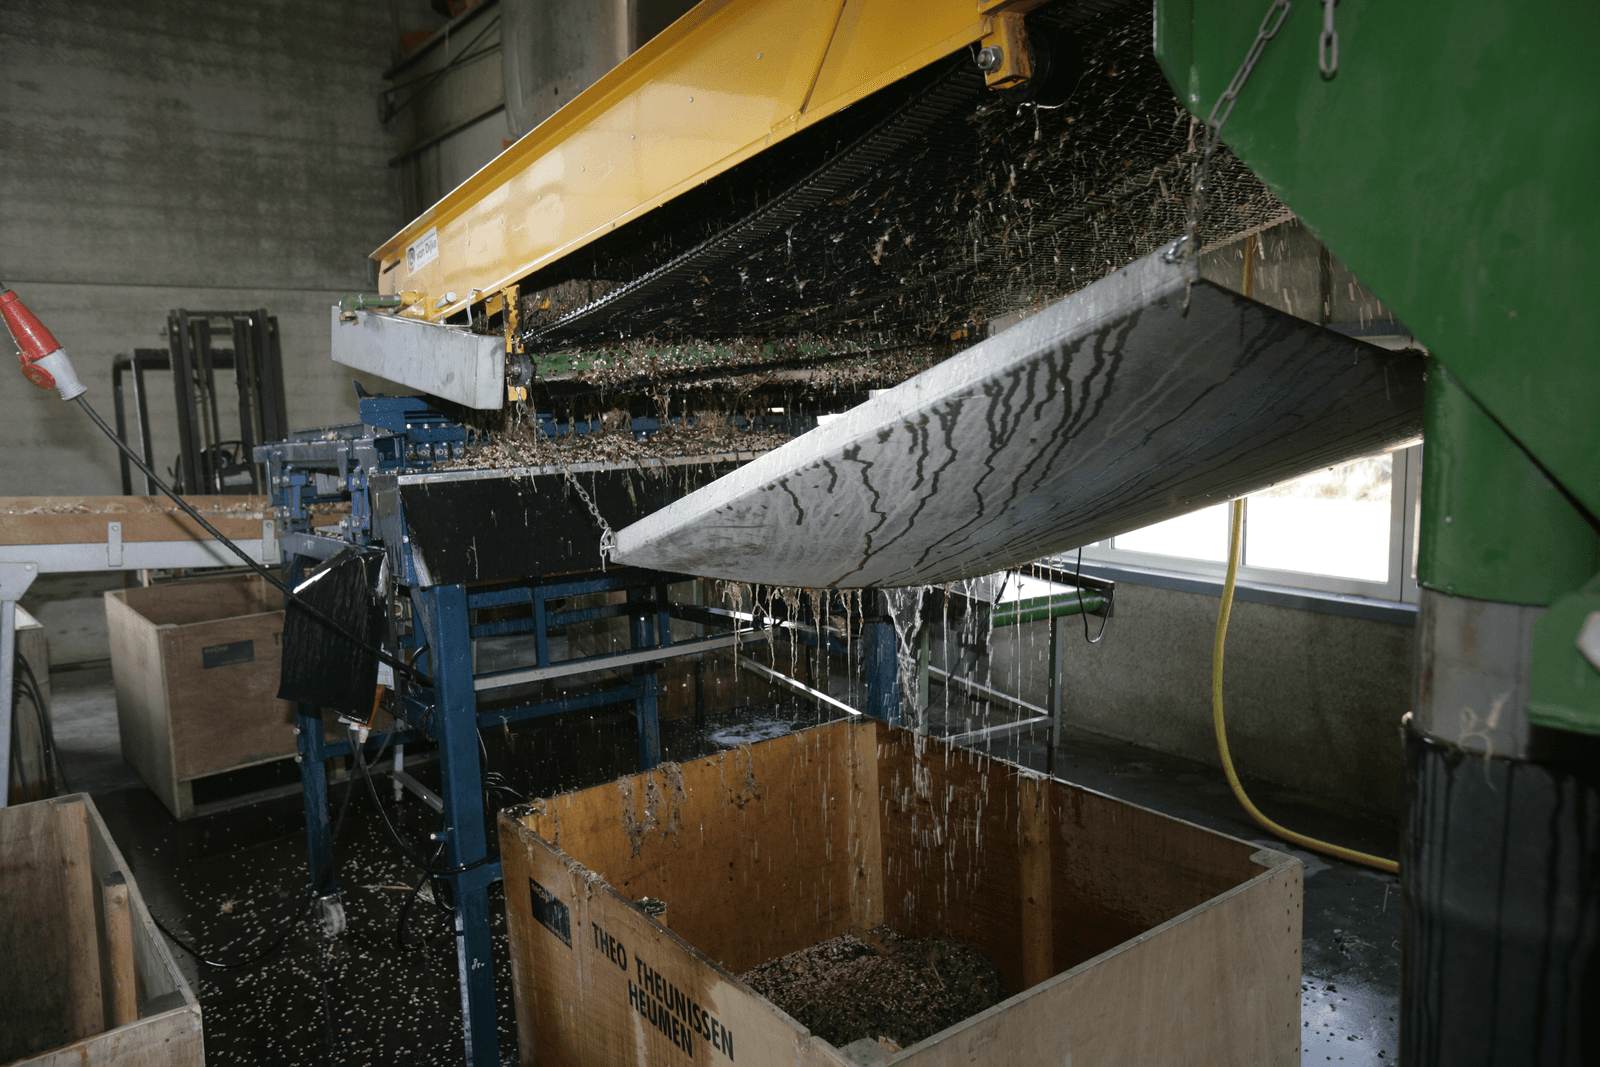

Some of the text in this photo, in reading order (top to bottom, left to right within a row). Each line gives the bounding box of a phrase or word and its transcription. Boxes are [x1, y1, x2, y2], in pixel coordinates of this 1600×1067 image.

[592, 921, 734, 1062] THEO THEUNISSEN
[628, 978, 693, 1059] HEUMEN
